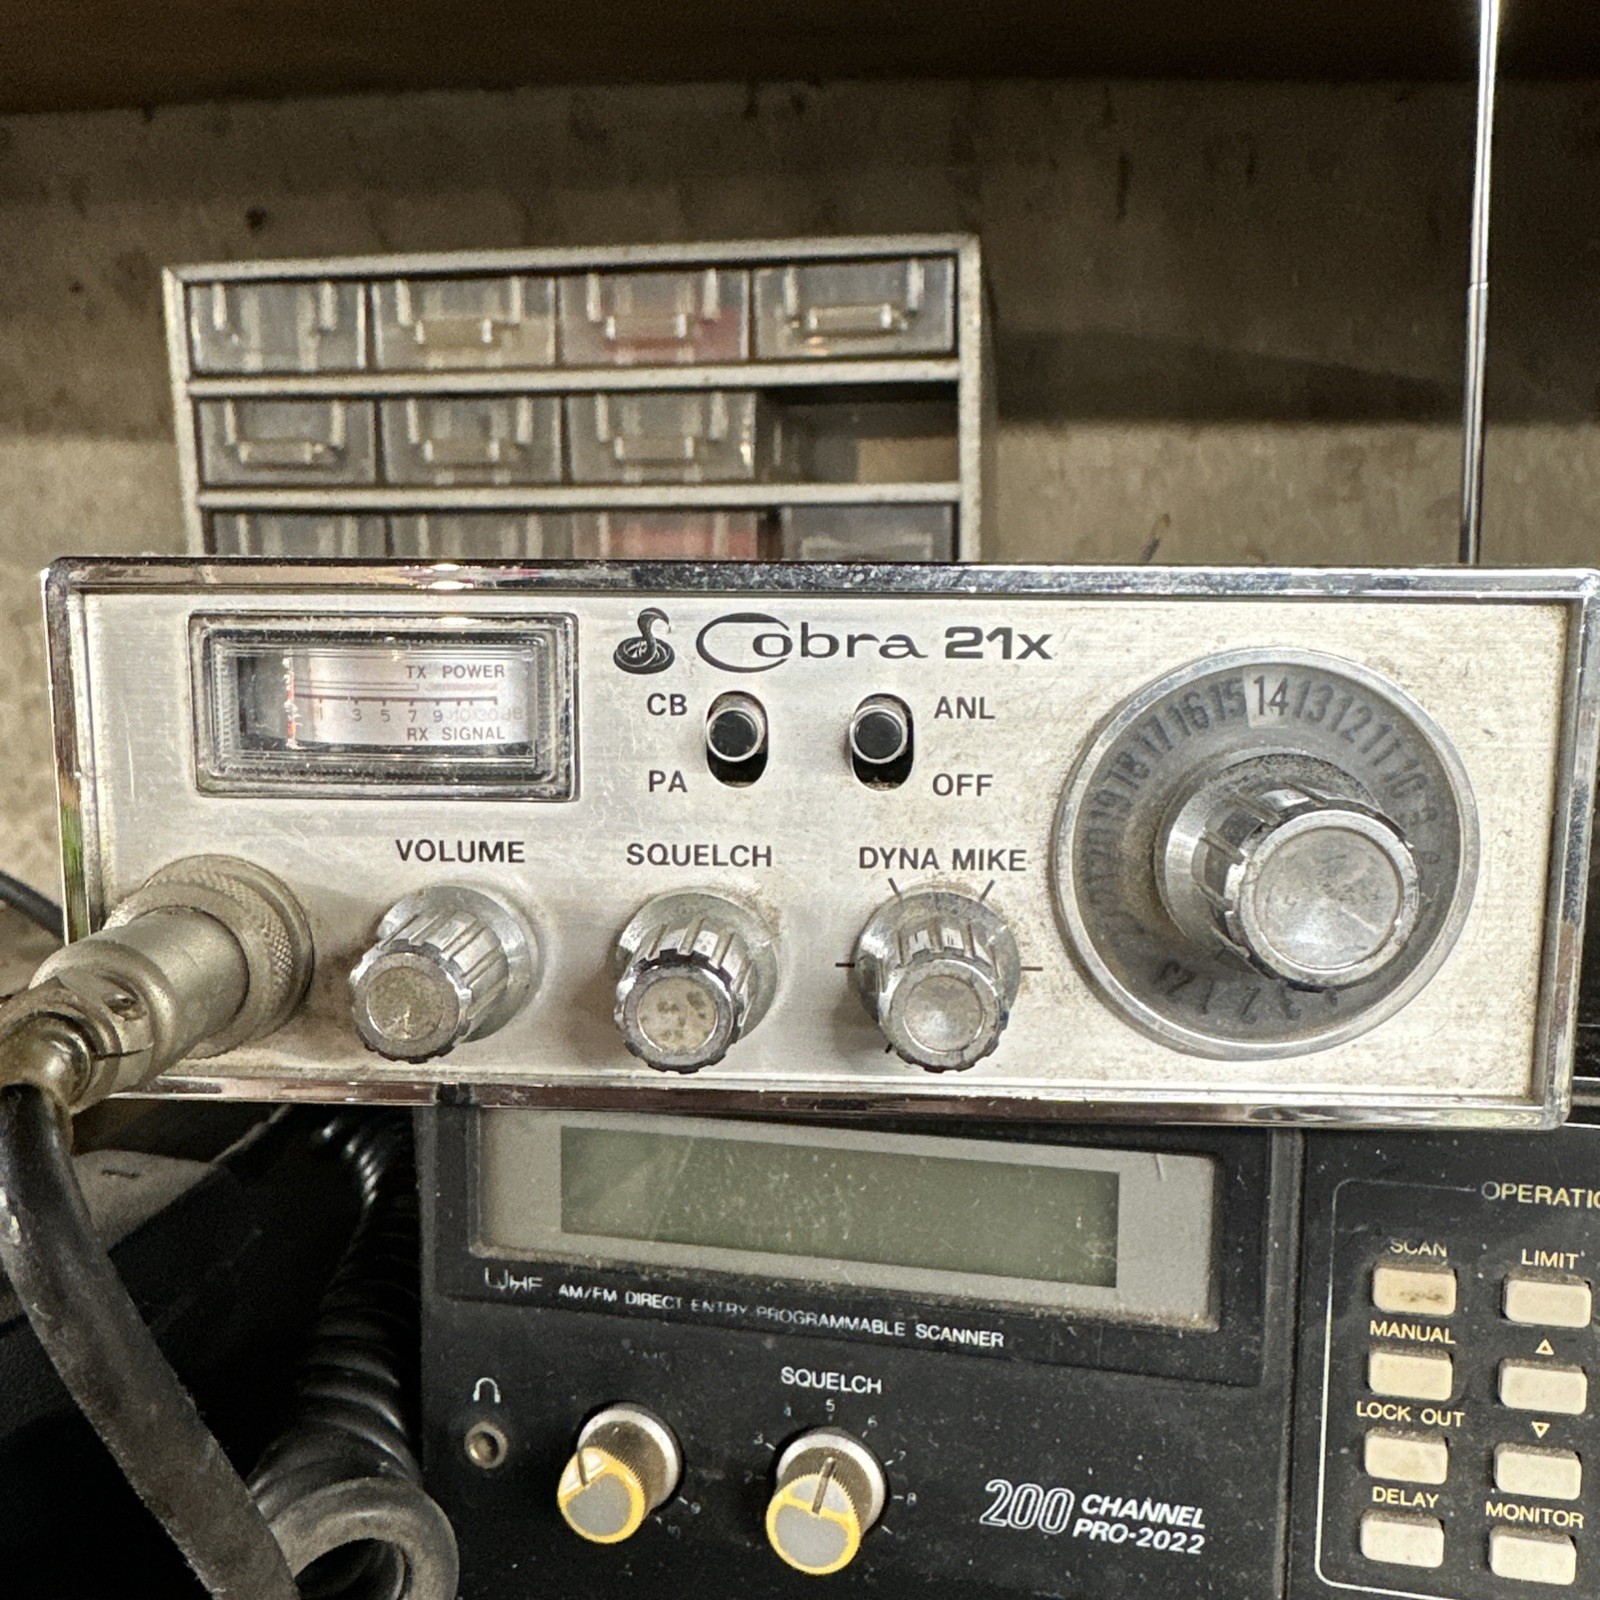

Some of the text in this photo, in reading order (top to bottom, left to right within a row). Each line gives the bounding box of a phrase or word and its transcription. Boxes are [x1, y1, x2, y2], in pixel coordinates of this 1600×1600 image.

[696, 612, 1053, 673] Cobra 21x
[406, 665, 505, 678] TX POWER
[647, 693, 688, 716] CB
[934, 696, 996, 720] ANL
[1254, 675, 1289, 716] 14
[1295, 680, 1334, 722] 13
[353, 708, 363, 722] 3
[381, 710, 391, 723] 5
[407, 710, 418, 723] 7
[433, 709, 443, 723] 9
[1168, 691, 1210, 737] 16
[1329, 697, 1373, 744] 12
[406, 726, 505, 741] RX SIGNAL
[1361, 723, 1402, 767] 11
[648, 770, 688, 793] PA
[932, 773, 993, 797] OFF
[395, 839, 525, 863] VOLUME
[626, 843, 773, 868] SQUELCH
[859, 847, 1027, 872] DYNA MIKE
[1389, 1239, 1448, 1258] SCAN
[1521, 1248, 1579, 1271] LIMIT
[558, 1284, 1004, 1348] AM/FM DIRECT ENTRY PROGRAMMABLE SCANNER
[1369, 1320, 1456, 1345] MANUAL
[781, 1366, 882, 1395] SQUELCH
[825, 1399, 835, 1412] 5
[1356, 1401, 1465, 1428] LOCK OUT
[979, 1479, 1206, 1535] 200 CHANNEL
[1372, 1486, 1439, 1509] DELAY
[1485, 1501, 1584, 1530] MONITOR
[1072, 1518, 1206, 1555] PRO-2022
